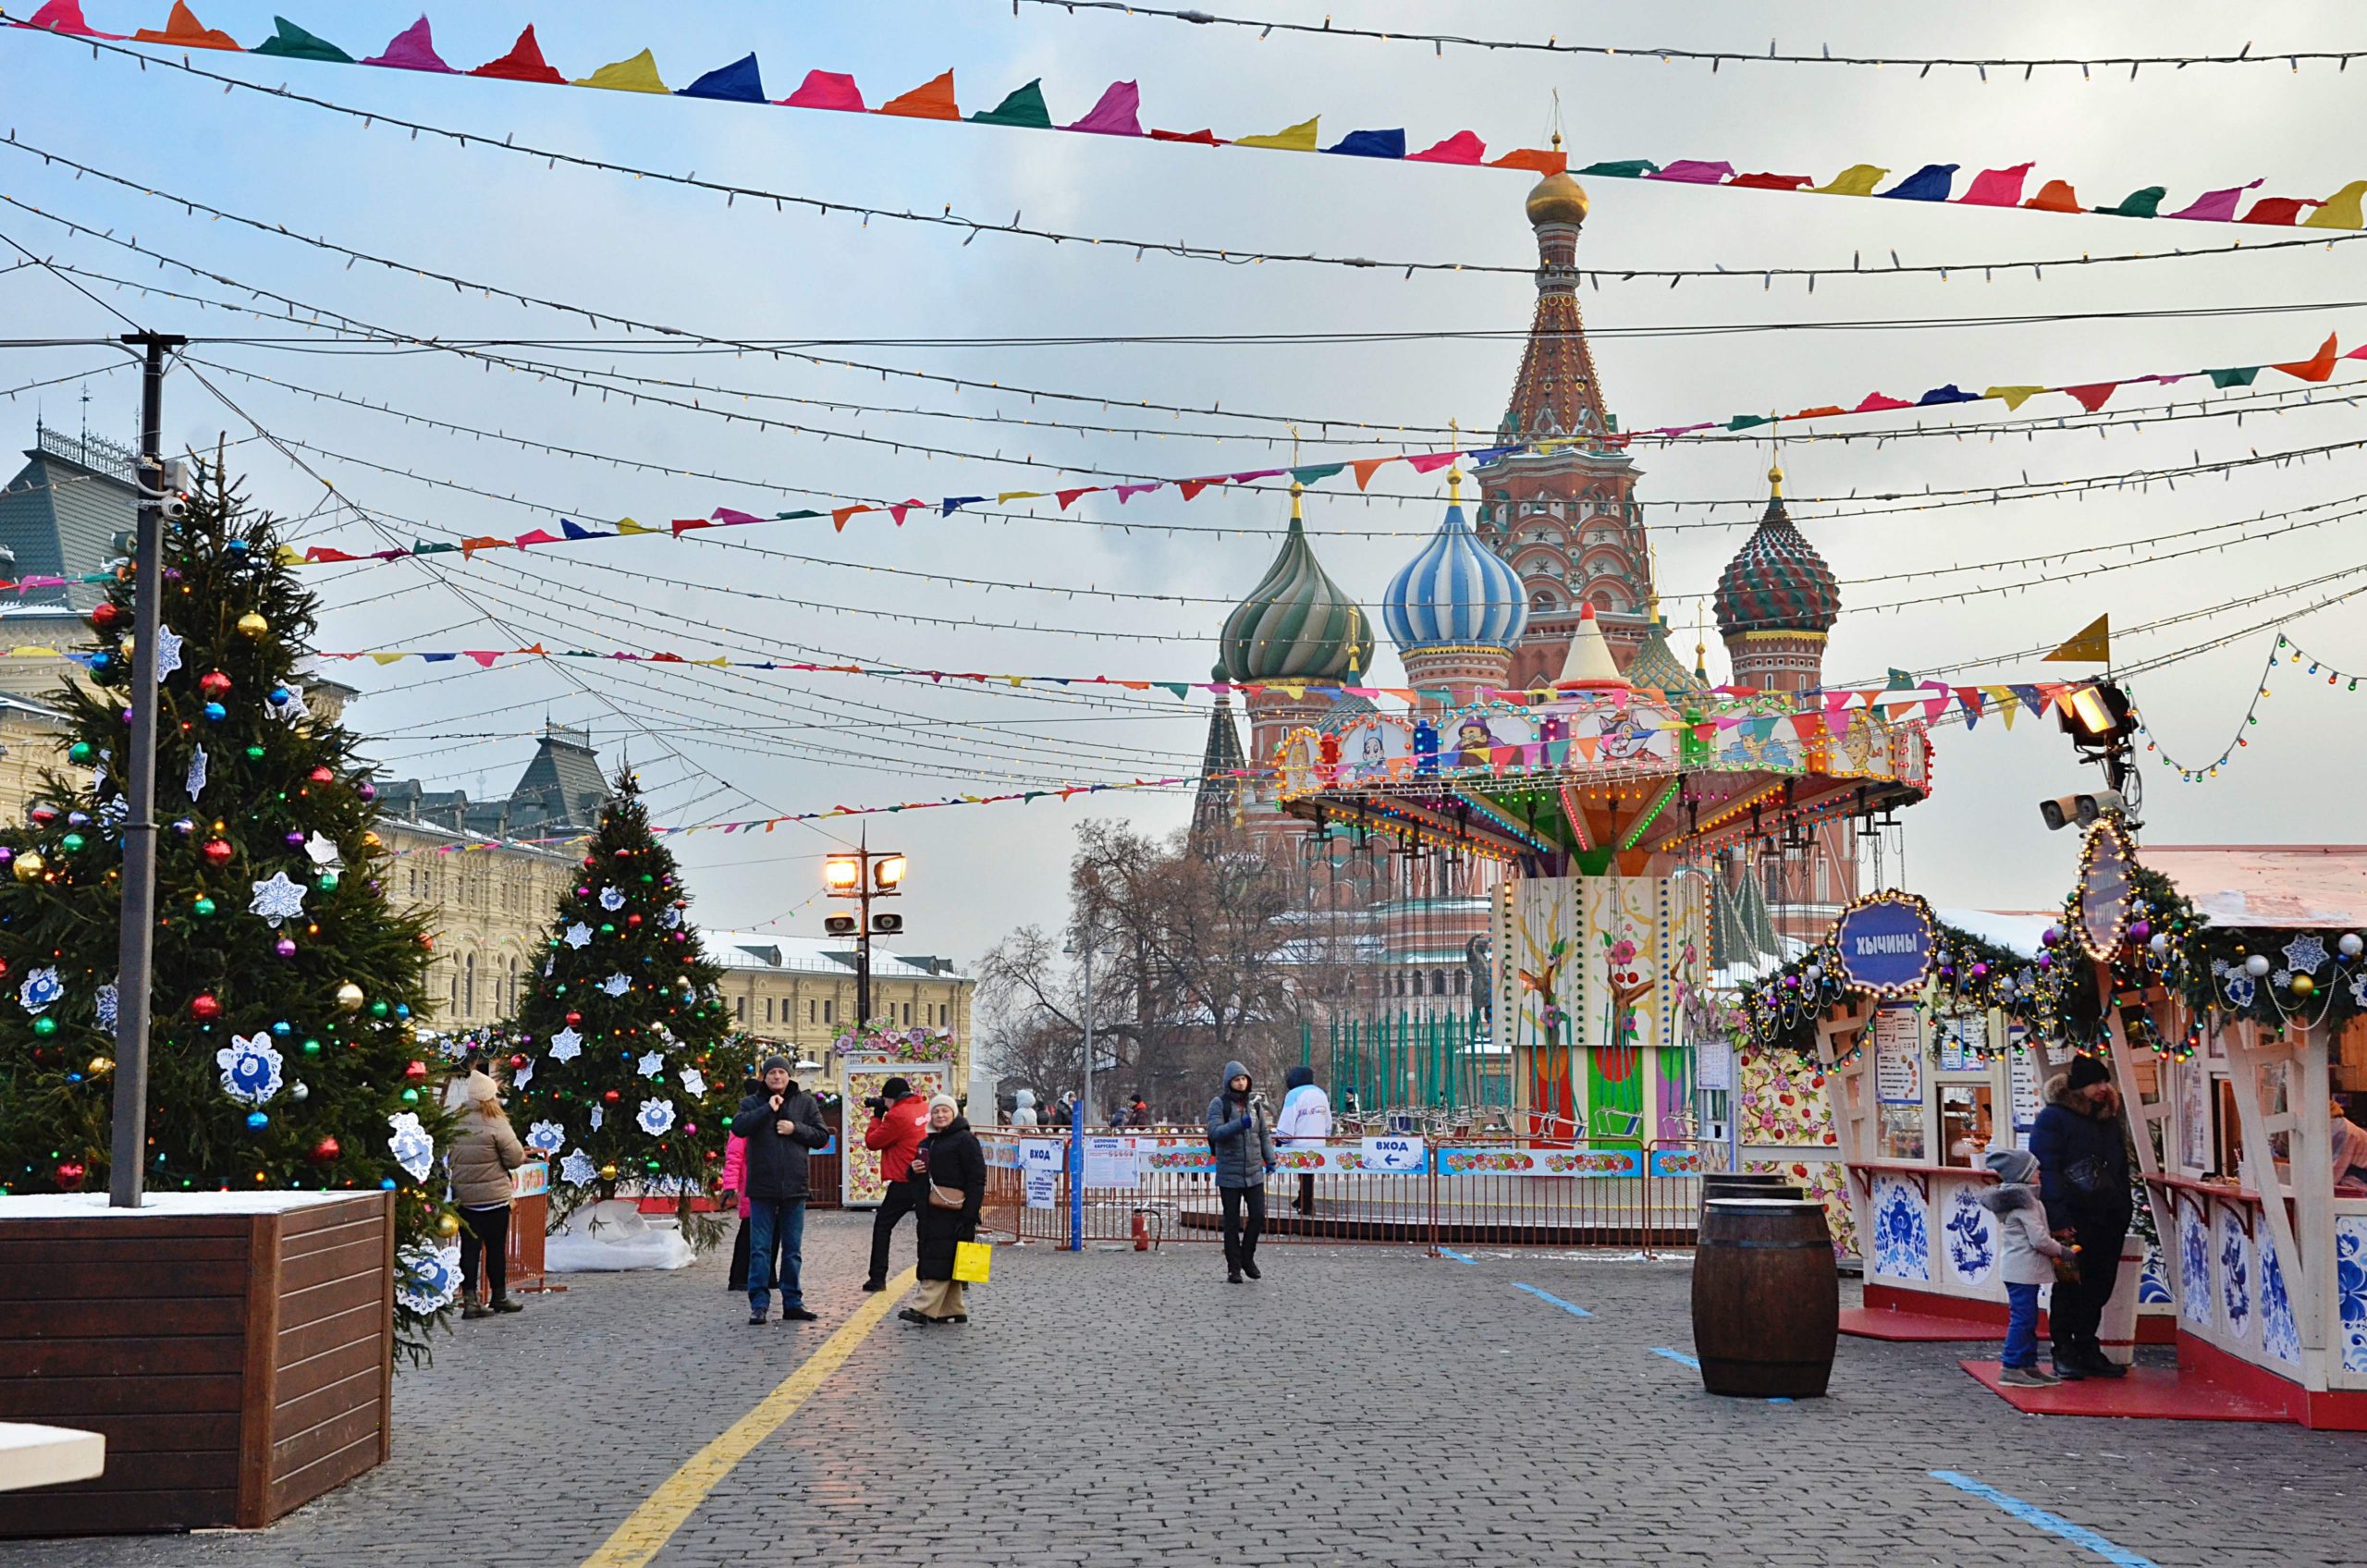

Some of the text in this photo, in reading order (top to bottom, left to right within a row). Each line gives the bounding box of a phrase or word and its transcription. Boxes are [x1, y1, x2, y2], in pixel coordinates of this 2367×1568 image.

[1856, 933, 1918, 955] ХЫЧИНЫ
[1376, 1142, 1408, 1152] ВХОД
[1029, 1149, 1050, 1161] ВХОД
